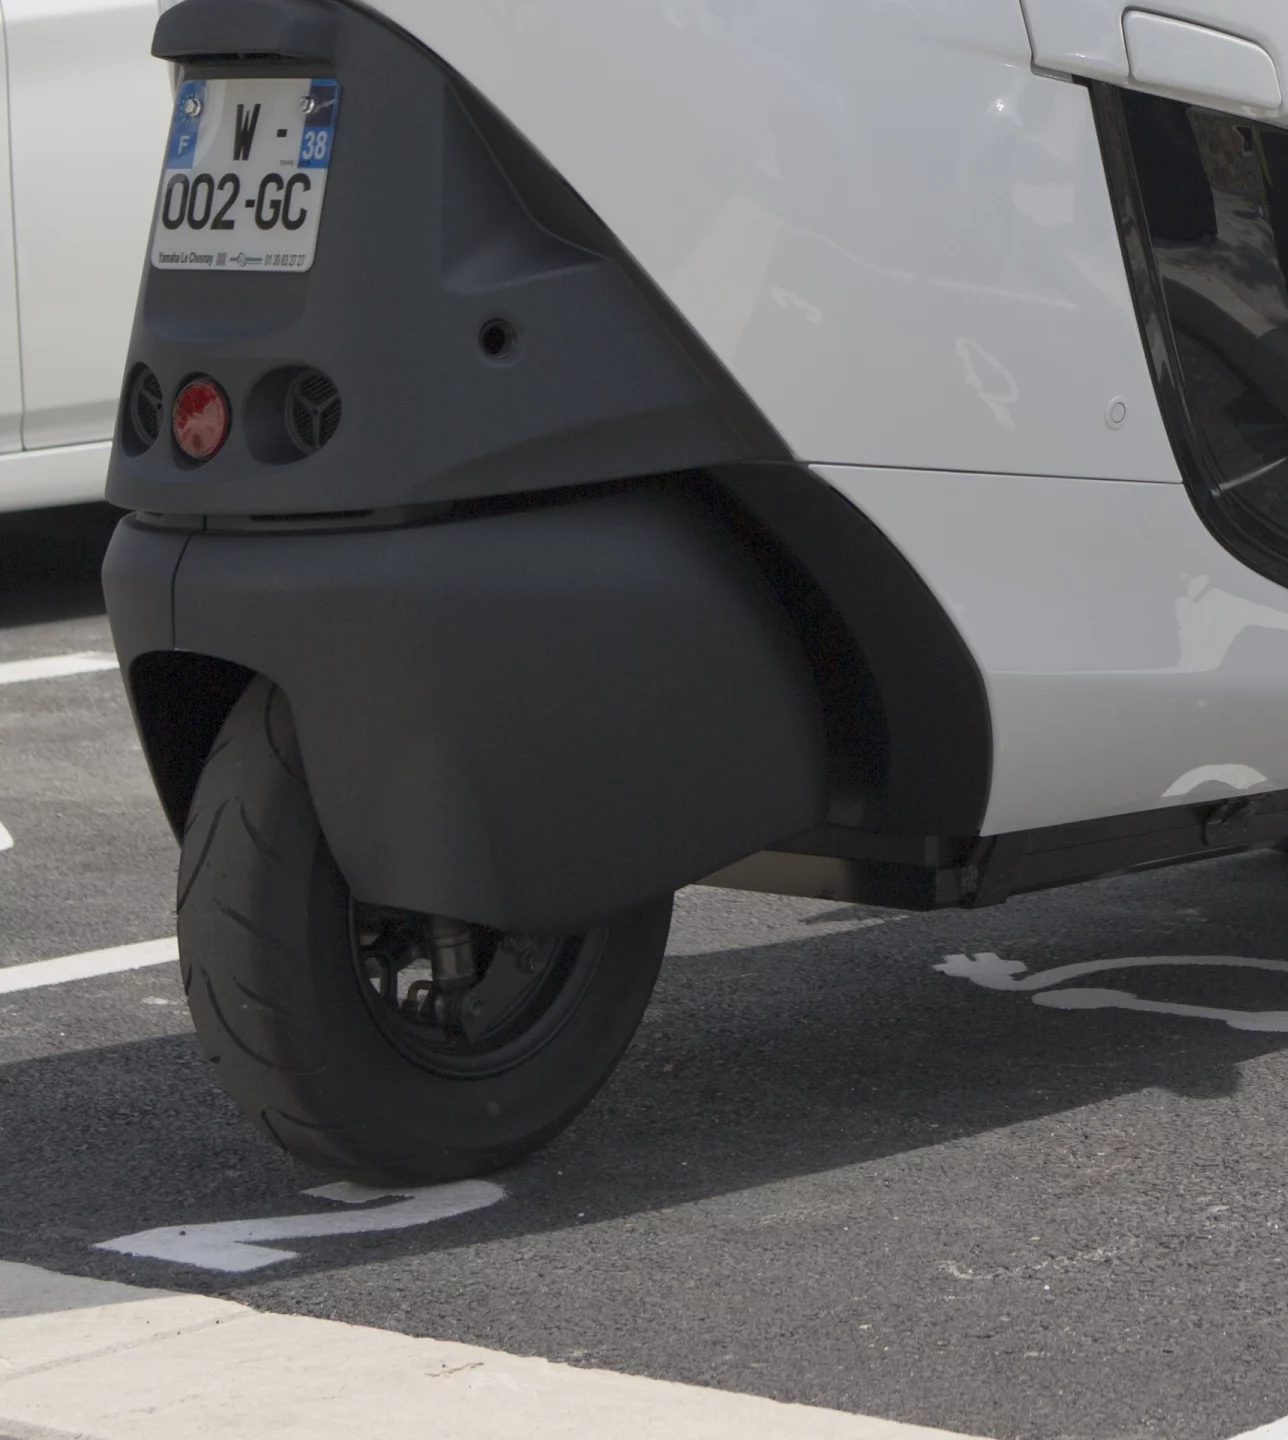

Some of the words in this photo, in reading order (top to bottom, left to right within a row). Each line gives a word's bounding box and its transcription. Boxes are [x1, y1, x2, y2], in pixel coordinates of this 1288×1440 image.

[178, 135, 191, 154] F
[302, 130, 328, 160] 38
[162, 172, 312, 231] 002-GC
[158, 251, 180, 264] Yamaha
